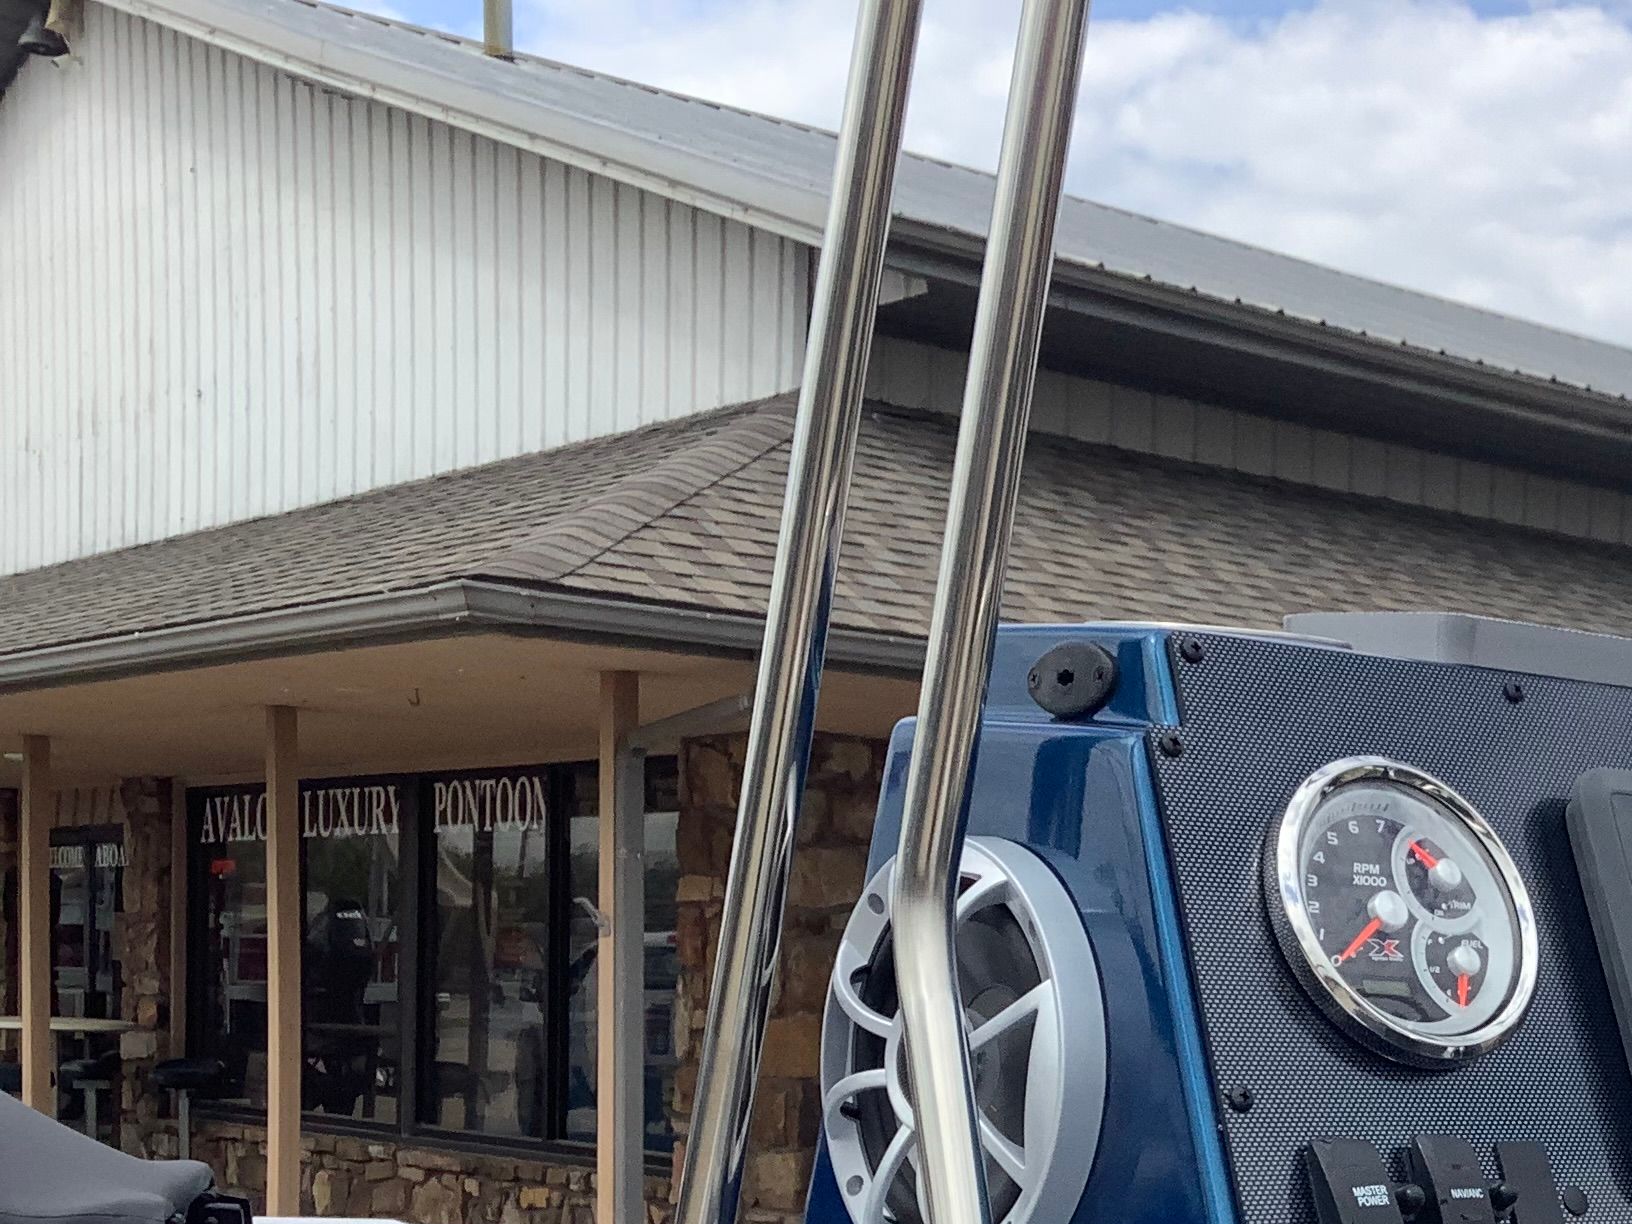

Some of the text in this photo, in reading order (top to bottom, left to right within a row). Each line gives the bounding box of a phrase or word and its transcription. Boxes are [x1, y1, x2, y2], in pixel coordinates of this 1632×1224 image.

[201, 793, 267, 843] AVALO
[303, 785, 399, 838] LUXURY
[1348, 820, 1359, 834] 6
[1376, 819, 1385, 832] 7
[1327, 831, 1338, 845] 5
[1313, 851, 1325, 864] 4
[1353, 862, 1380, 875] RPM
[1307, 874, 1318, 887] 3
[1308, 900, 1319, 913] 2
[1319, 929, 1325, 940] 1
[1461, 939, 1484, 949] FUEL
[1351, 1185, 1388, 1197] MASTER
[1357, 1194, 1390, 1207] POWER
